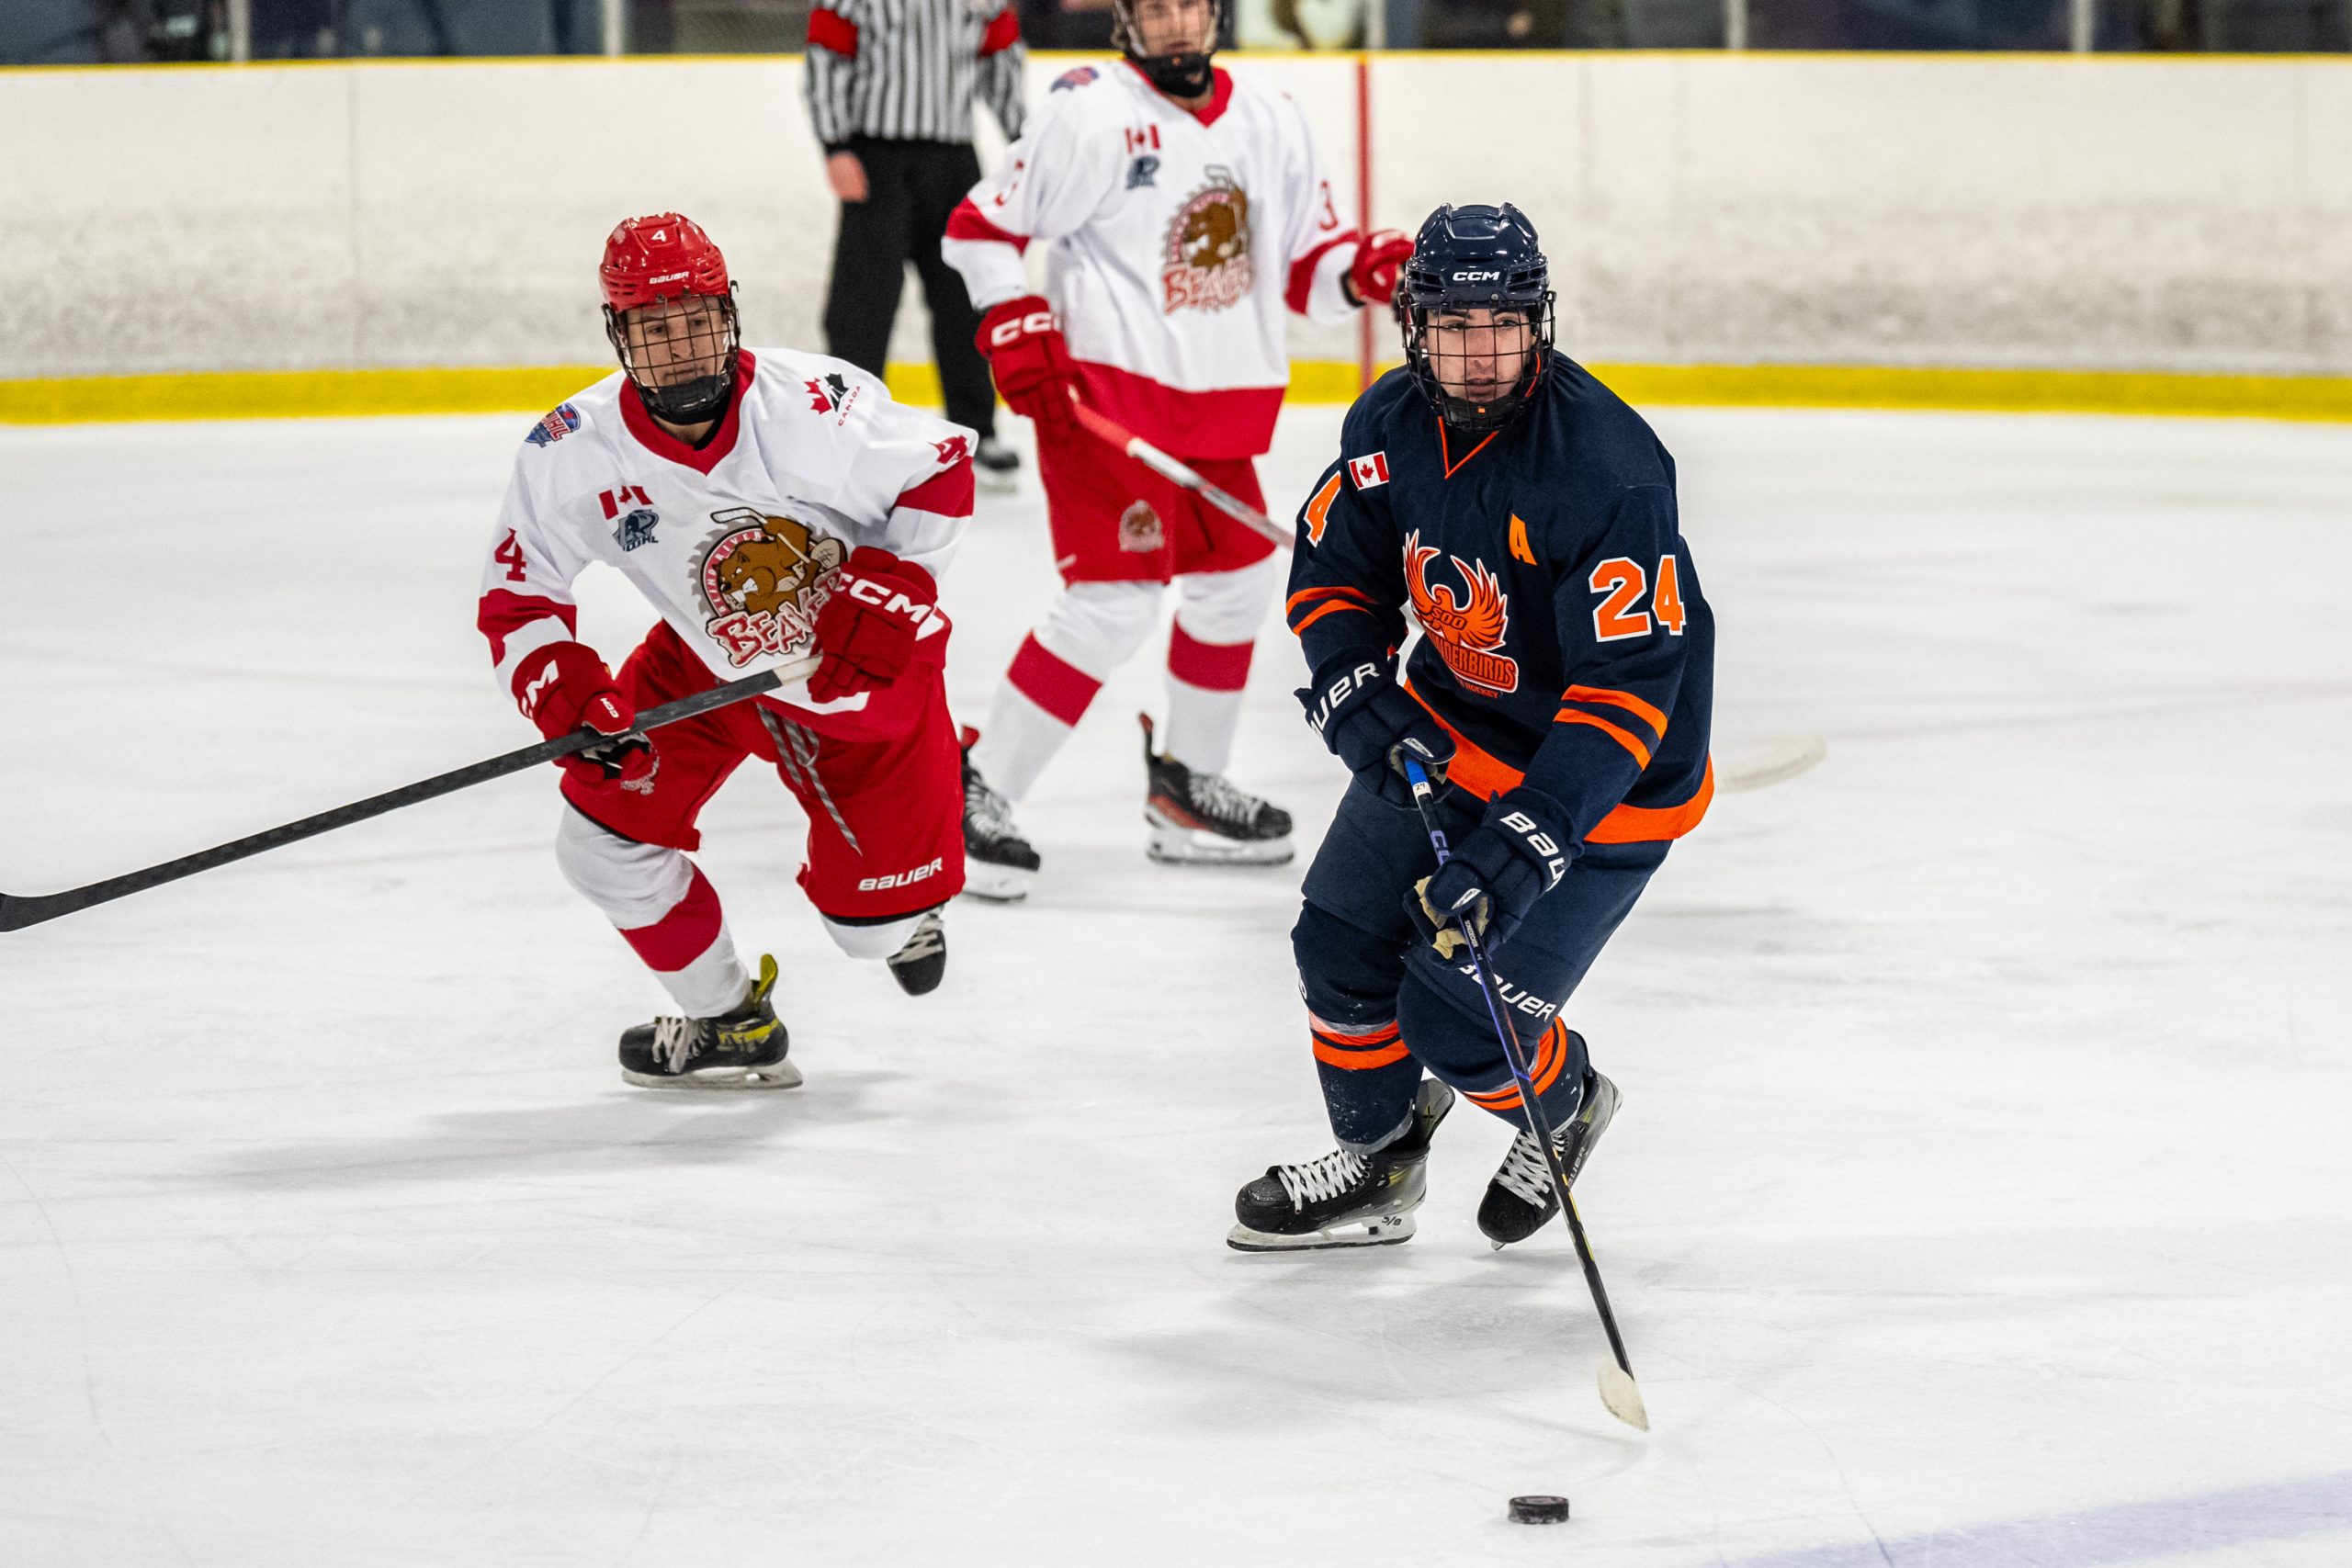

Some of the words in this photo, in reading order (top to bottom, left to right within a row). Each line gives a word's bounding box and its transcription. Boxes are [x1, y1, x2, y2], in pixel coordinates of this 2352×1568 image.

[651, 230, 667, 242] 4
[649, 271, 689, 285] BAUER
[1453, 271, 1500, 281] CCM
[990, 310, 1061, 346] CC
[838, 386, 861, 426] CANADA
[493, 527, 526, 582] 4
[715, 531, 763, 561] RIVER
[1509, 513, 1538, 566] A
[706, 569, 727, 614] BLIND
[1589, 555, 1687, 642] 24
[1432, 606, 1467, 631] SOO
[1310, 663, 1380, 738] UER
[1499, 812, 1566, 892] BAU
[858, 856, 943, 891] BAUER
